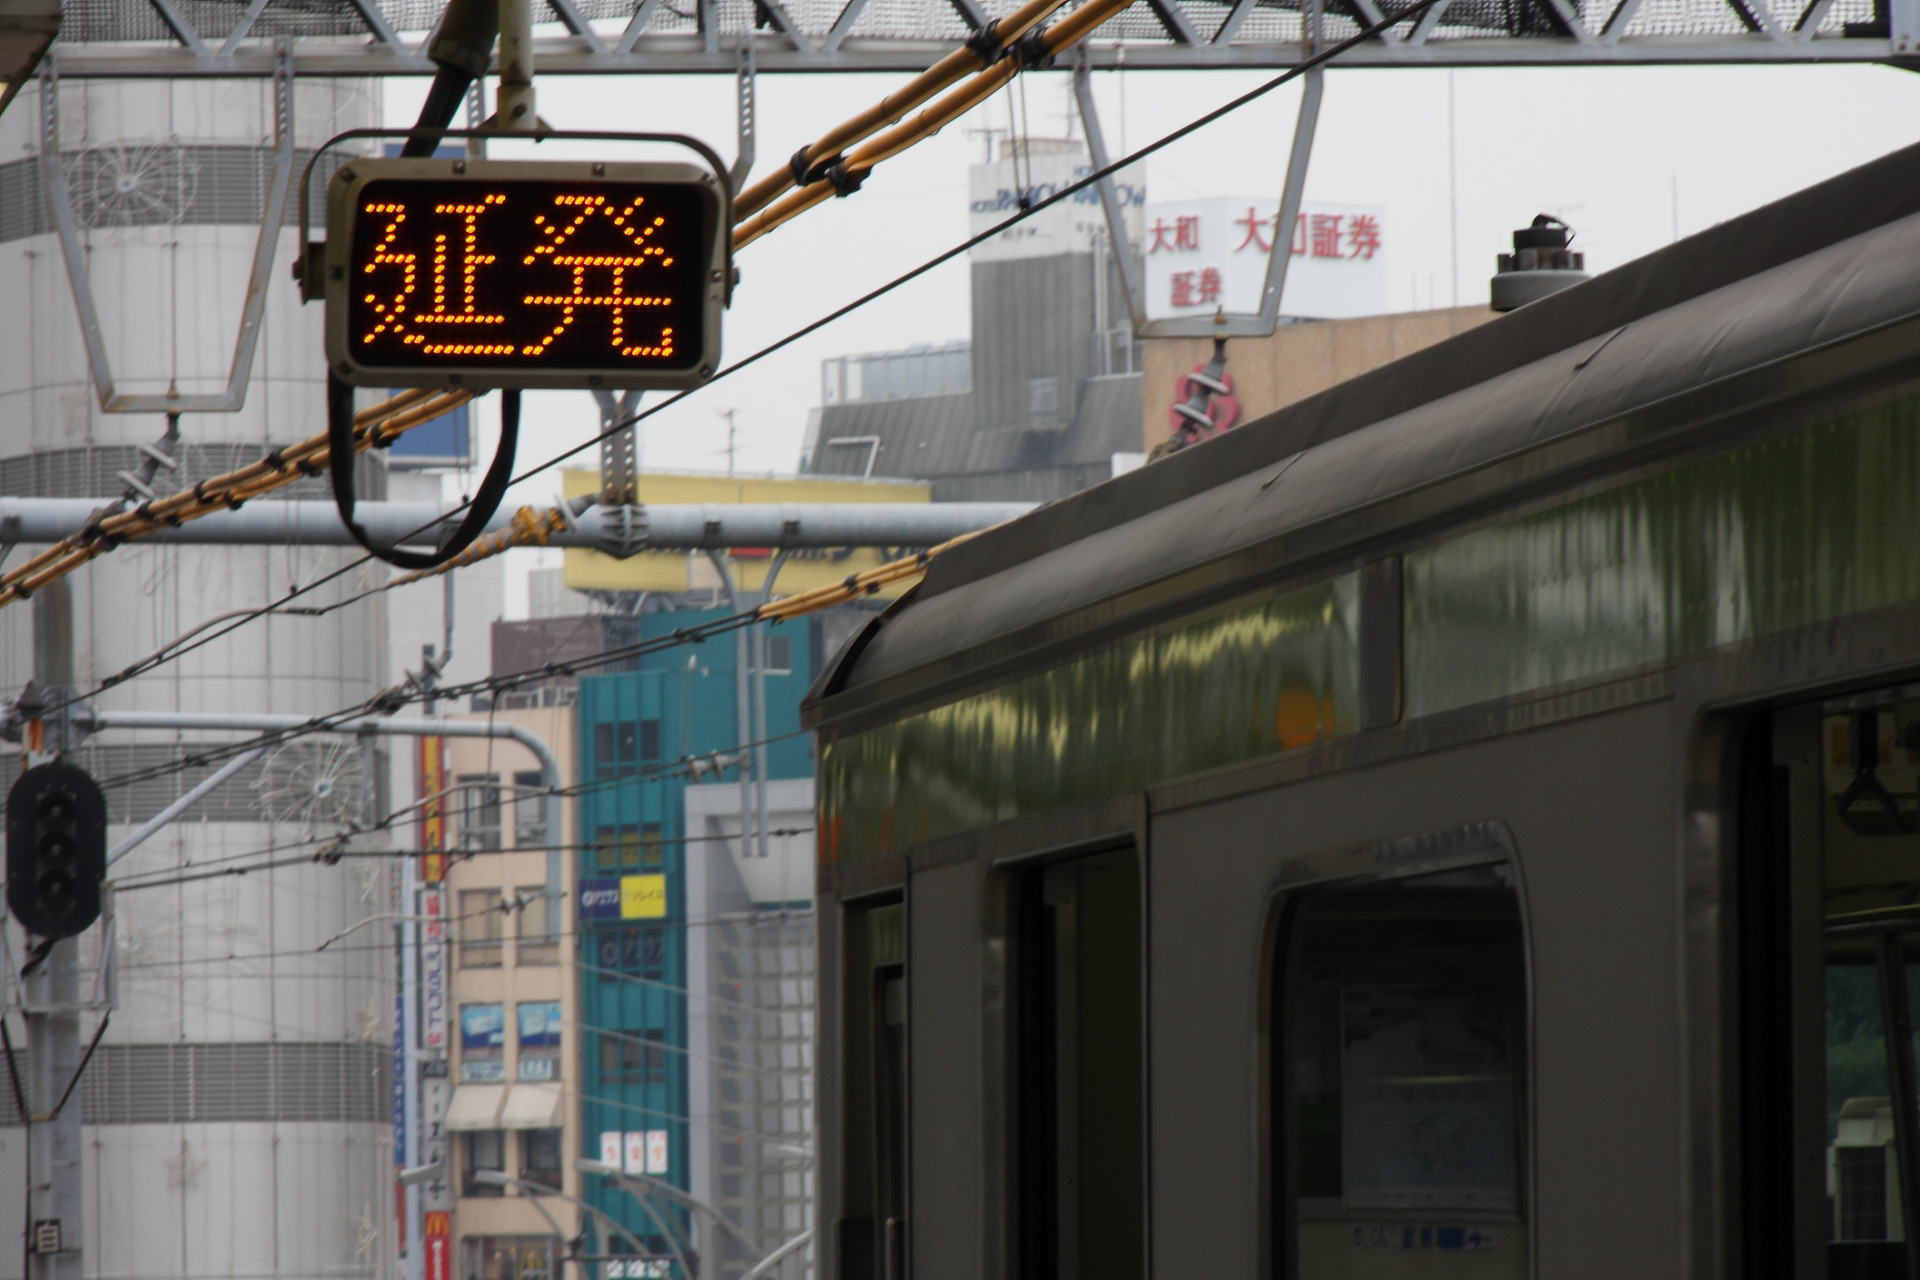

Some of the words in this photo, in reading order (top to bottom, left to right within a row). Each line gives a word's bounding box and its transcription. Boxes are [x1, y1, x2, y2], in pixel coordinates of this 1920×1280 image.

[1148, 215, 1199, 254] 大和
[365, 194, 673, 356] 延発
[1170, 267, 1221, 308] 証券
